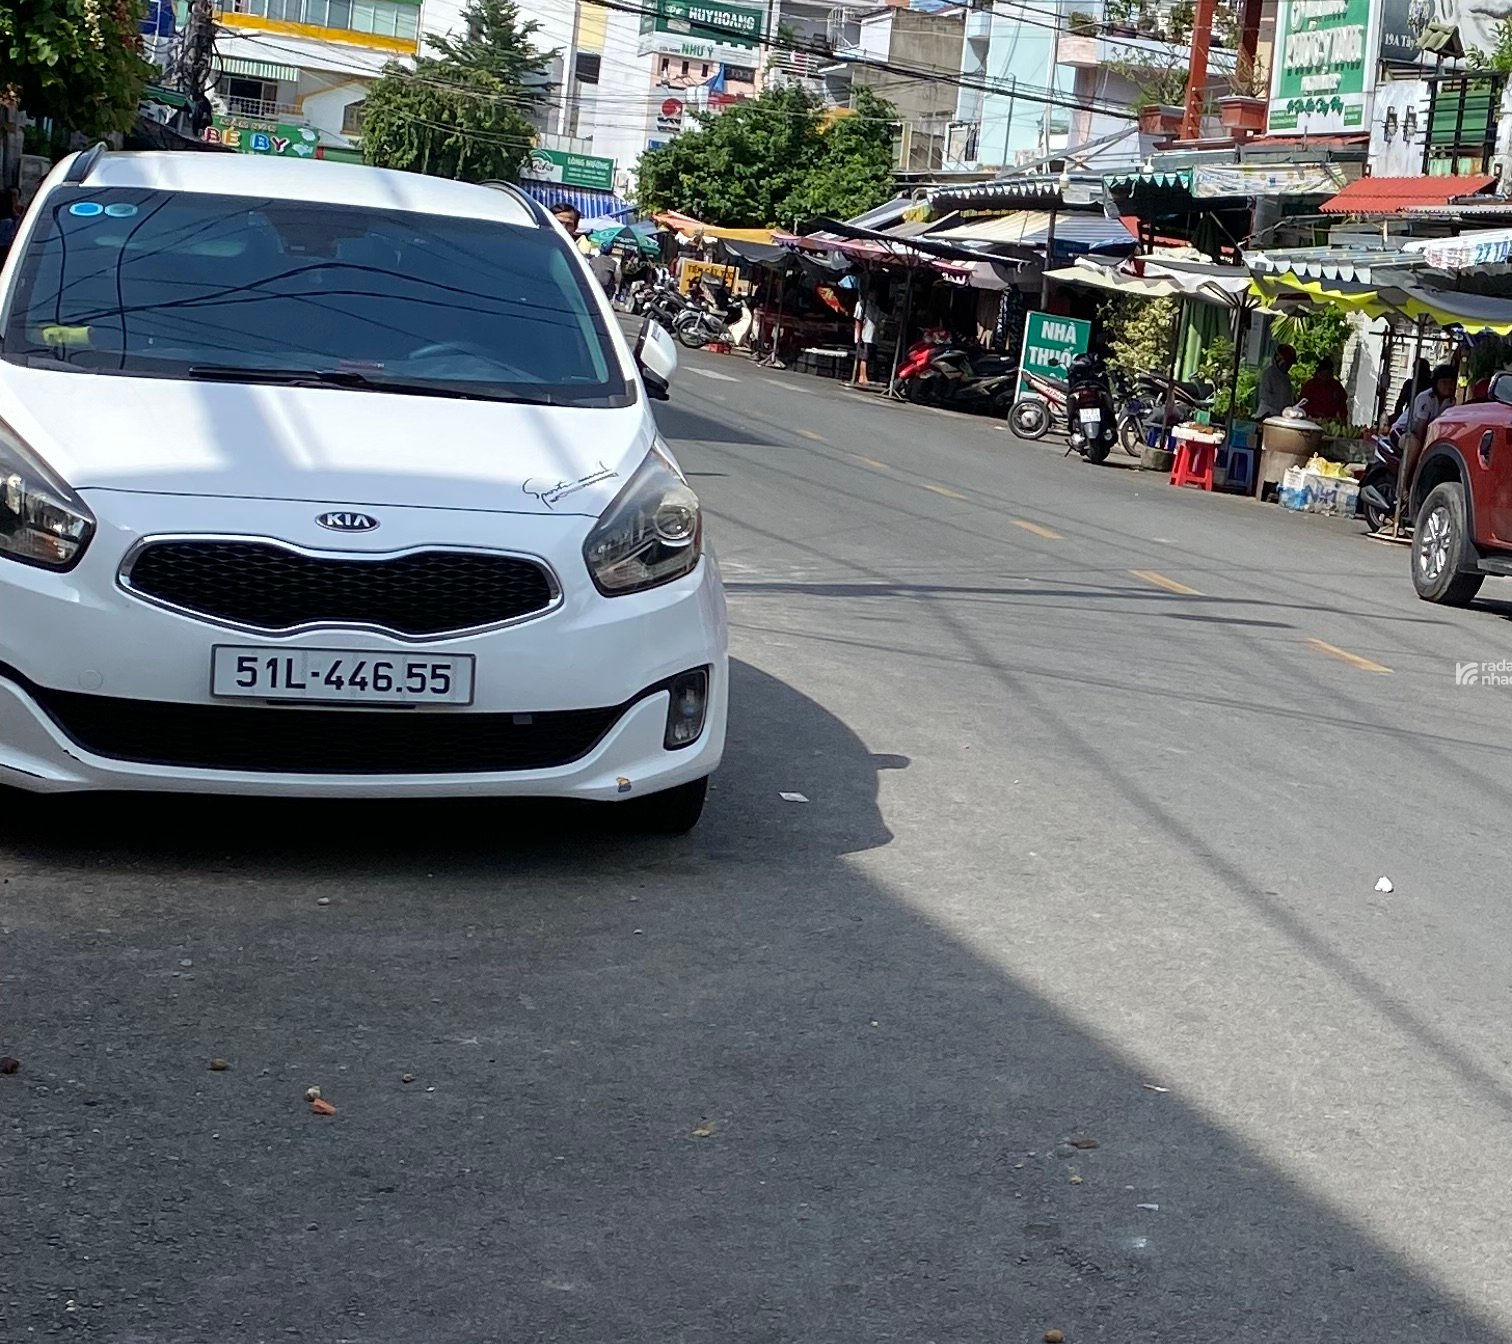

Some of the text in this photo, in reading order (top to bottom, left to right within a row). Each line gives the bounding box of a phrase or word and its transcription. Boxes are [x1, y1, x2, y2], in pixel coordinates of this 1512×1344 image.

[250, 133, 290, 153] BY
[1041, 320, 1077, 344] NHÀ
[326, 513, 371, 528] KIA
[236, 656, 452, 695] 51L-446.55
